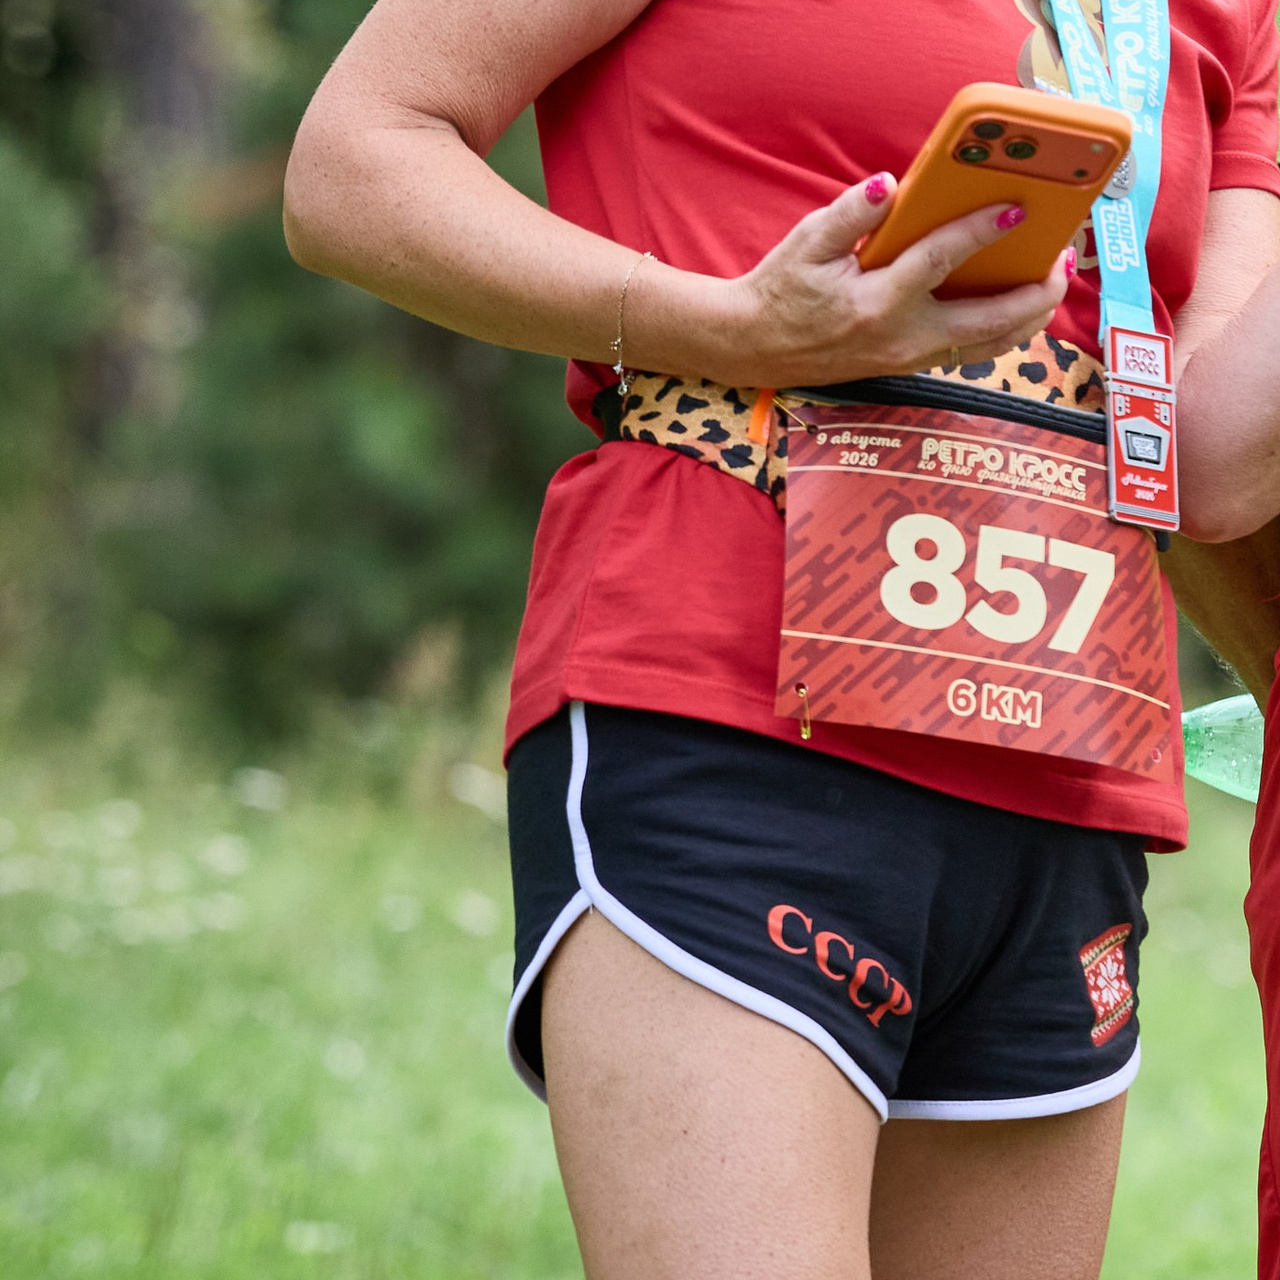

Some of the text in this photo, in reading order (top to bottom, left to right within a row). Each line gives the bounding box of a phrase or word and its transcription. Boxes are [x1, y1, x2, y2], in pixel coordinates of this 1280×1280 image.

[1114, 31, 1146, 133] ЕТРО
[1104, 209, 1124, 272] СОЮЗ
[816, 430, 902, 450] 9 августа
[840, 451, 878, 466] 2026
[922, 438, 1087, 492] РЕТРО КРОСС
[917, 460, 936, 470] ко
[941, 463, 974, 478] дню
[880, 513, 1116, 654] 857
[947, 678, 978, 717] 6
[767, 904, 912, 1028] СССР
